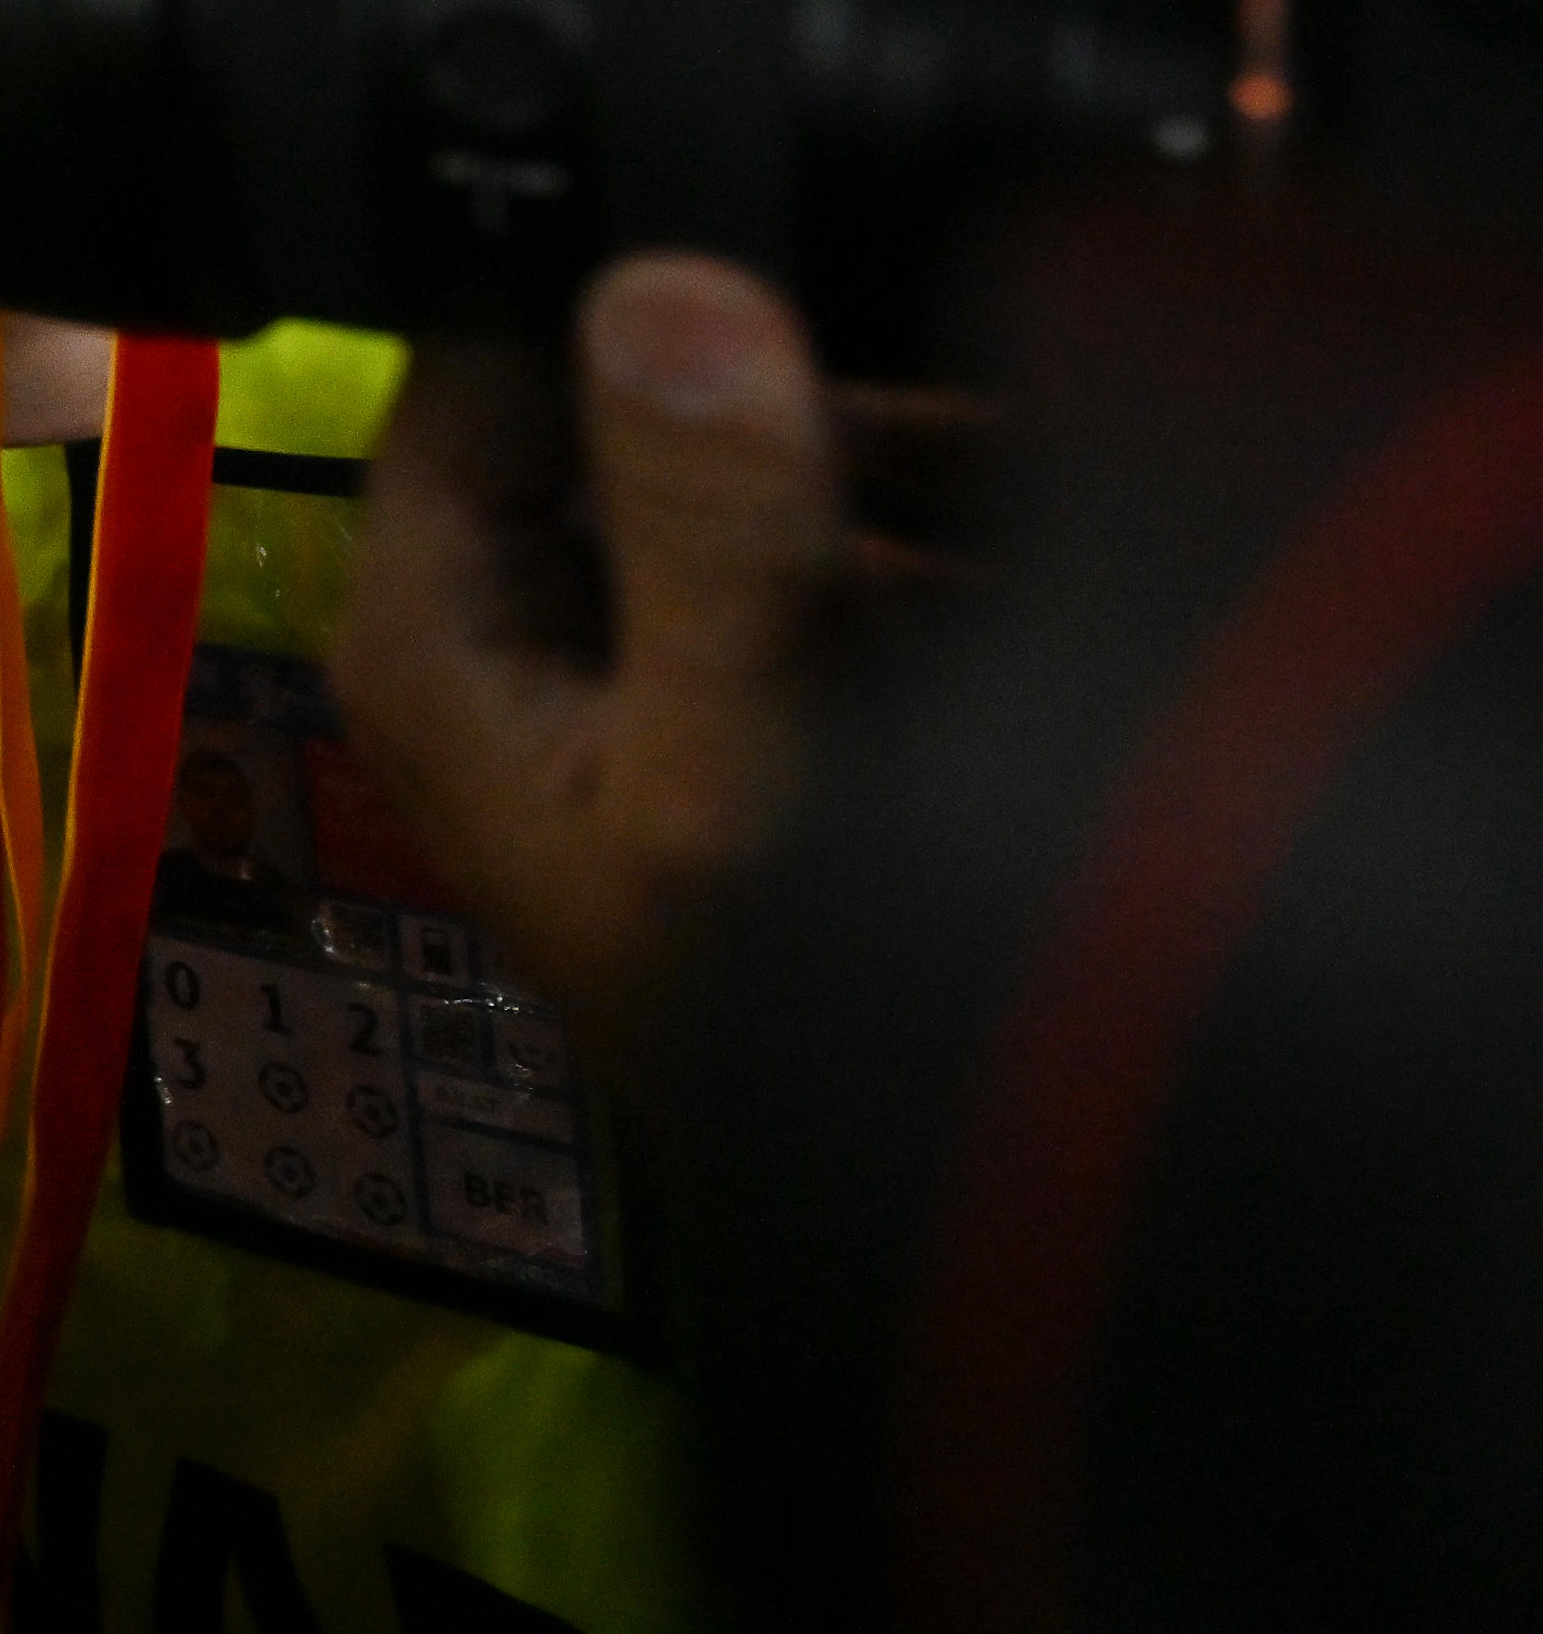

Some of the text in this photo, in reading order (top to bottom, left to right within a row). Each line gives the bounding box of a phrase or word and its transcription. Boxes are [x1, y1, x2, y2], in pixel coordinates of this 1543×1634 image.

[165, 961, 380, 1058] 0 1 2
[173, 1038, 207, 1091] 3
